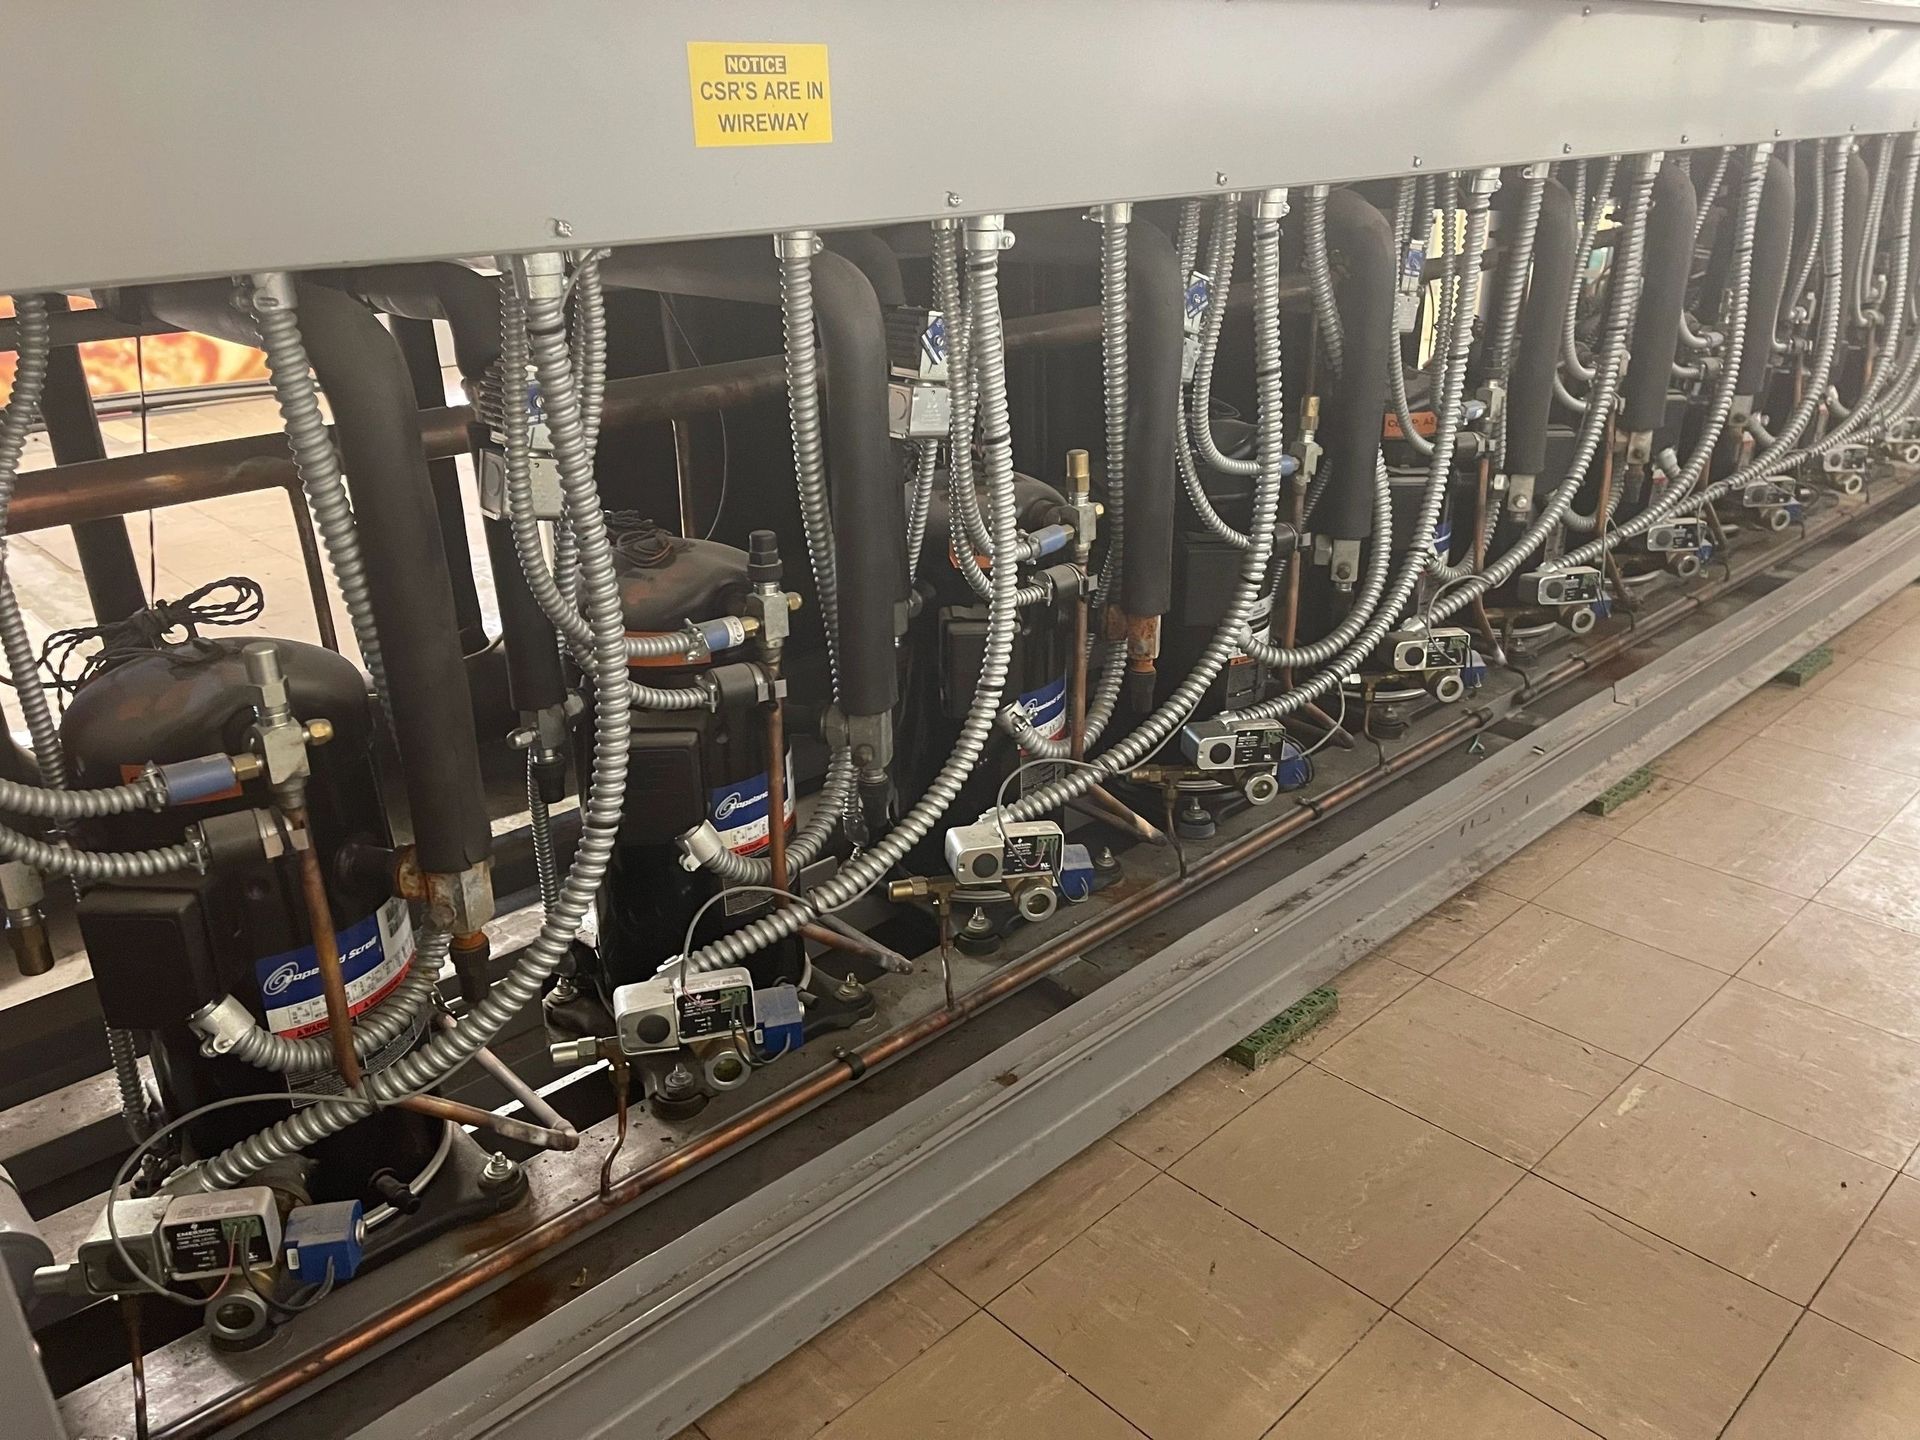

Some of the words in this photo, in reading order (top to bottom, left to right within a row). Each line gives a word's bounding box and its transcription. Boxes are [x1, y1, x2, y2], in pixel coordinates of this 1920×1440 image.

[726, 56, 785, 73] NOTICE
[700, 81, 757, 101] CSR'S
[763, 81, 801, 101] ARE
[806, 81, 823, 100] IN
[717, 112, 809, 133] WIREWAY
[348, 935, 377, 960] Scroll
